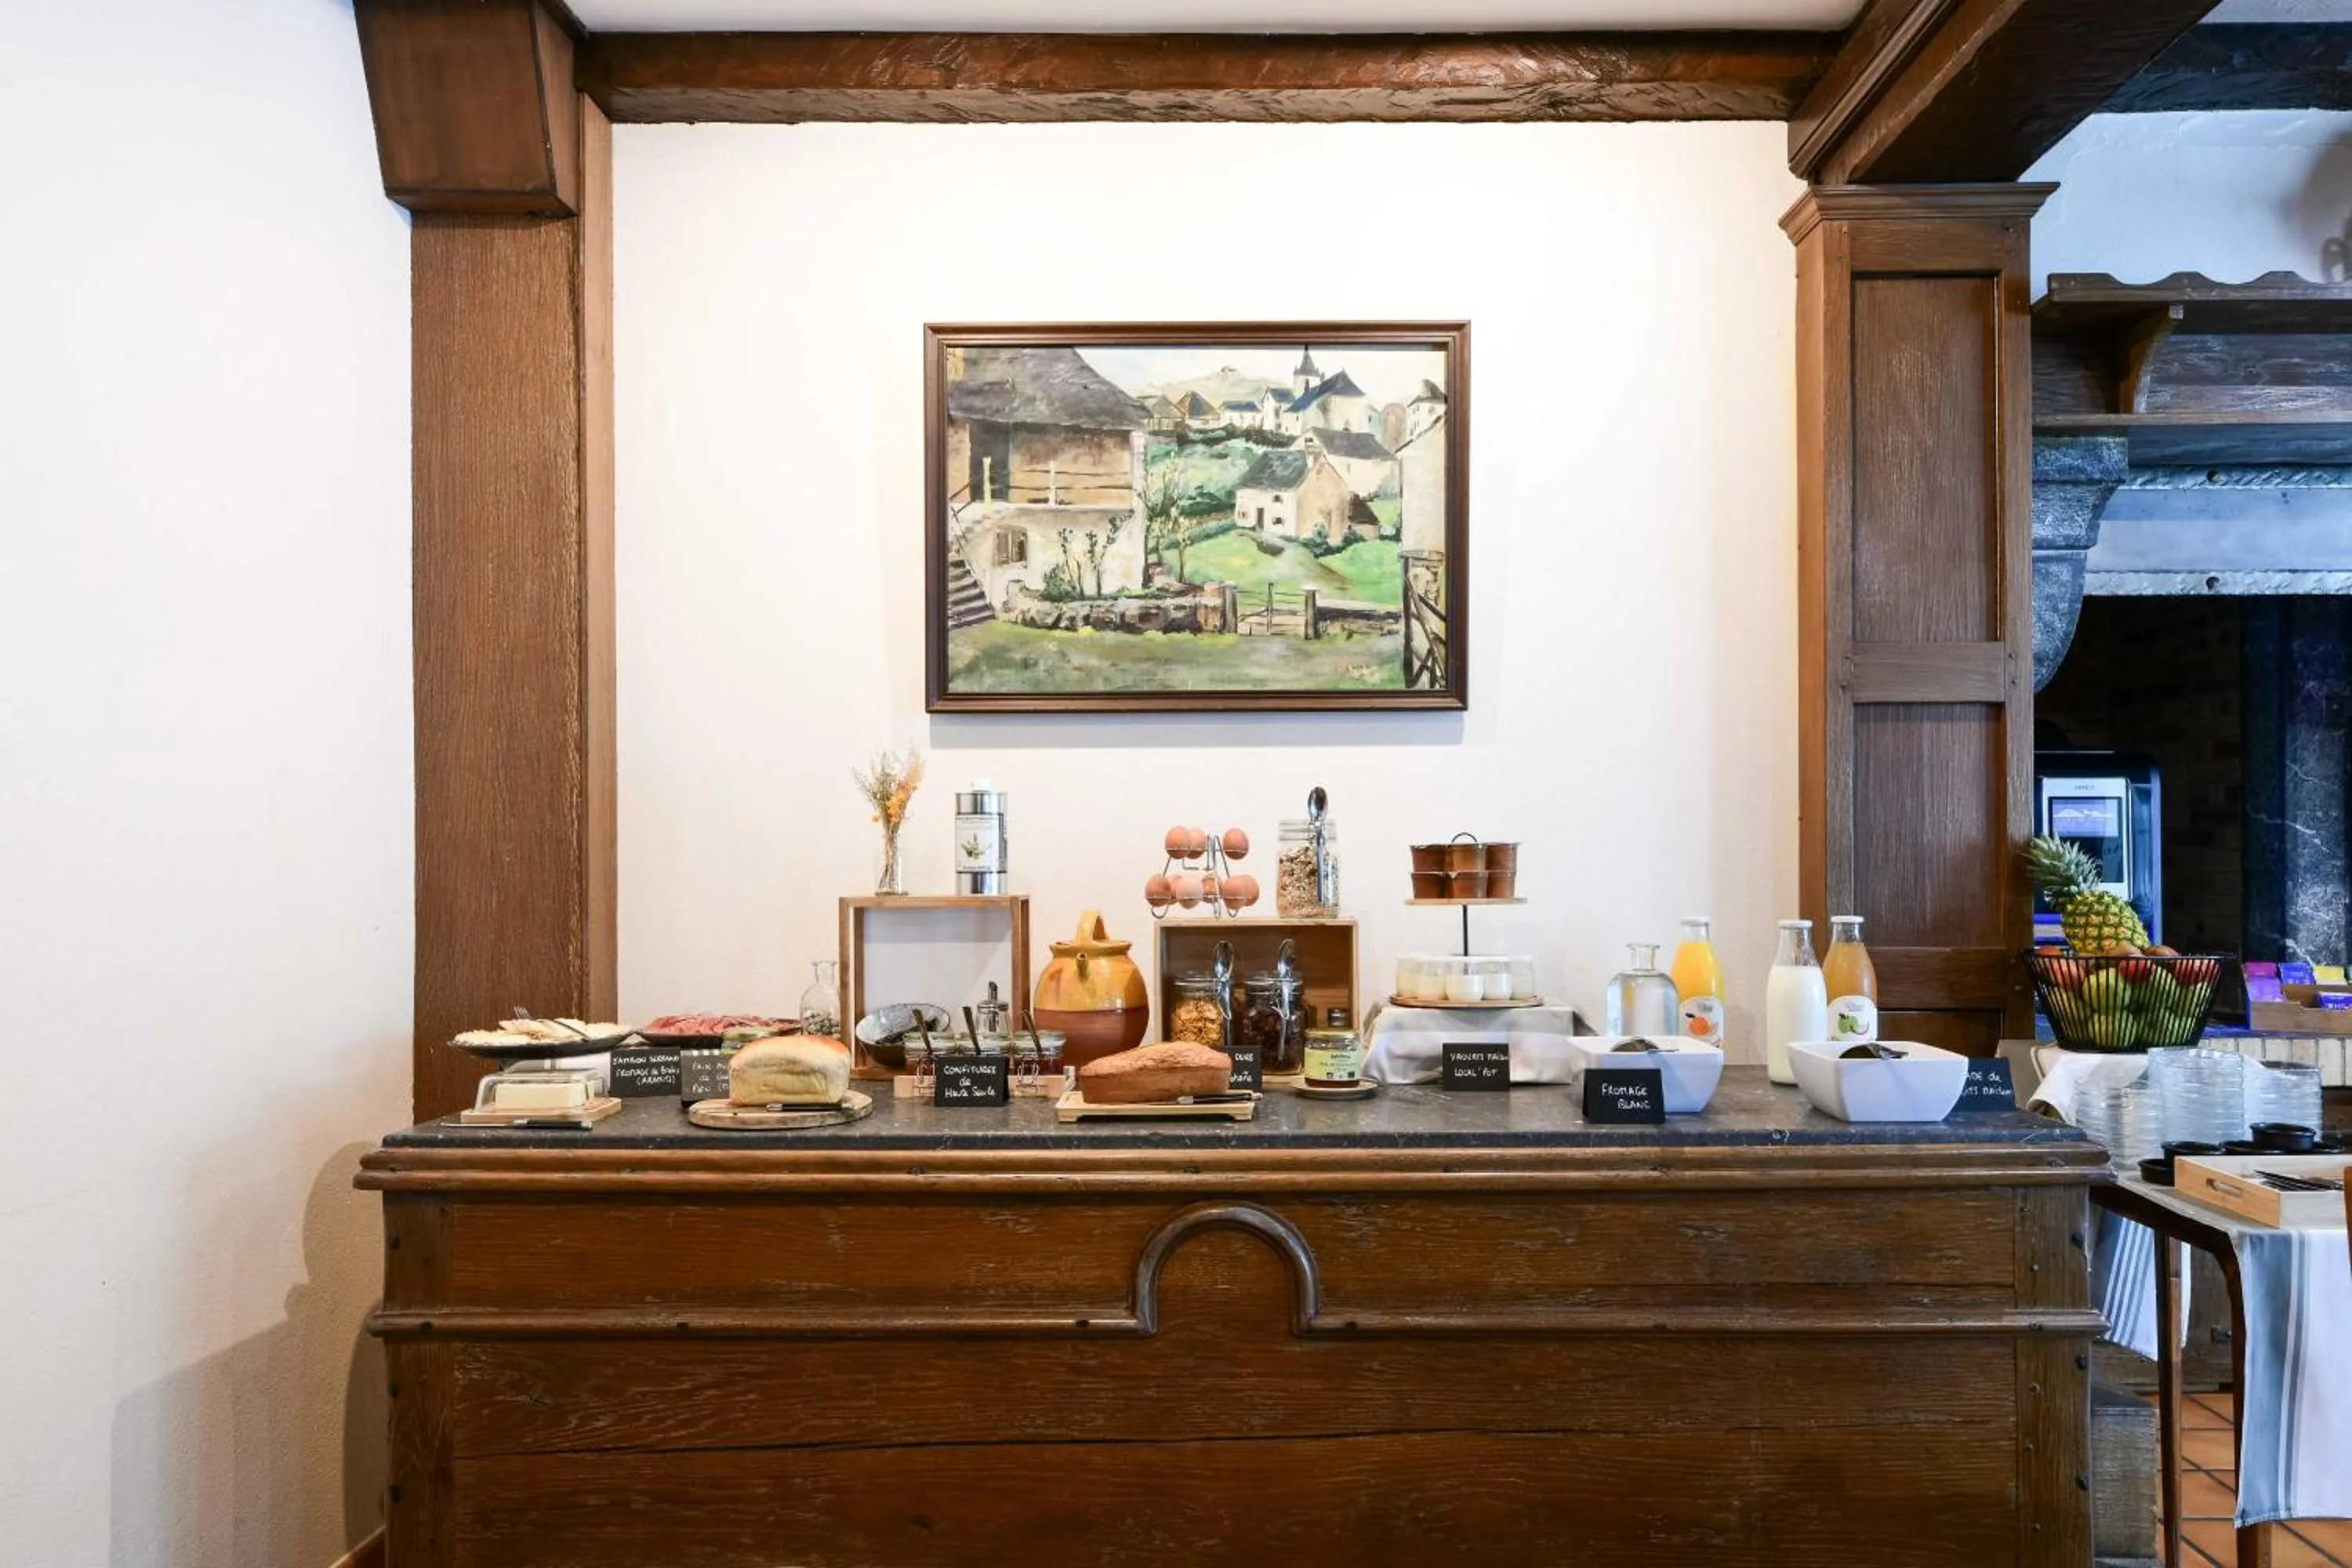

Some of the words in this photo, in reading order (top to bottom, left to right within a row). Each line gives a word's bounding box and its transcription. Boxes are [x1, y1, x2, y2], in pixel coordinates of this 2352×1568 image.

[959, 1076, 971, 1086] de
[1602, 1082, 1648, 1096] FROMAGE
[1617, 1098, 1651, 1109] BLANC
